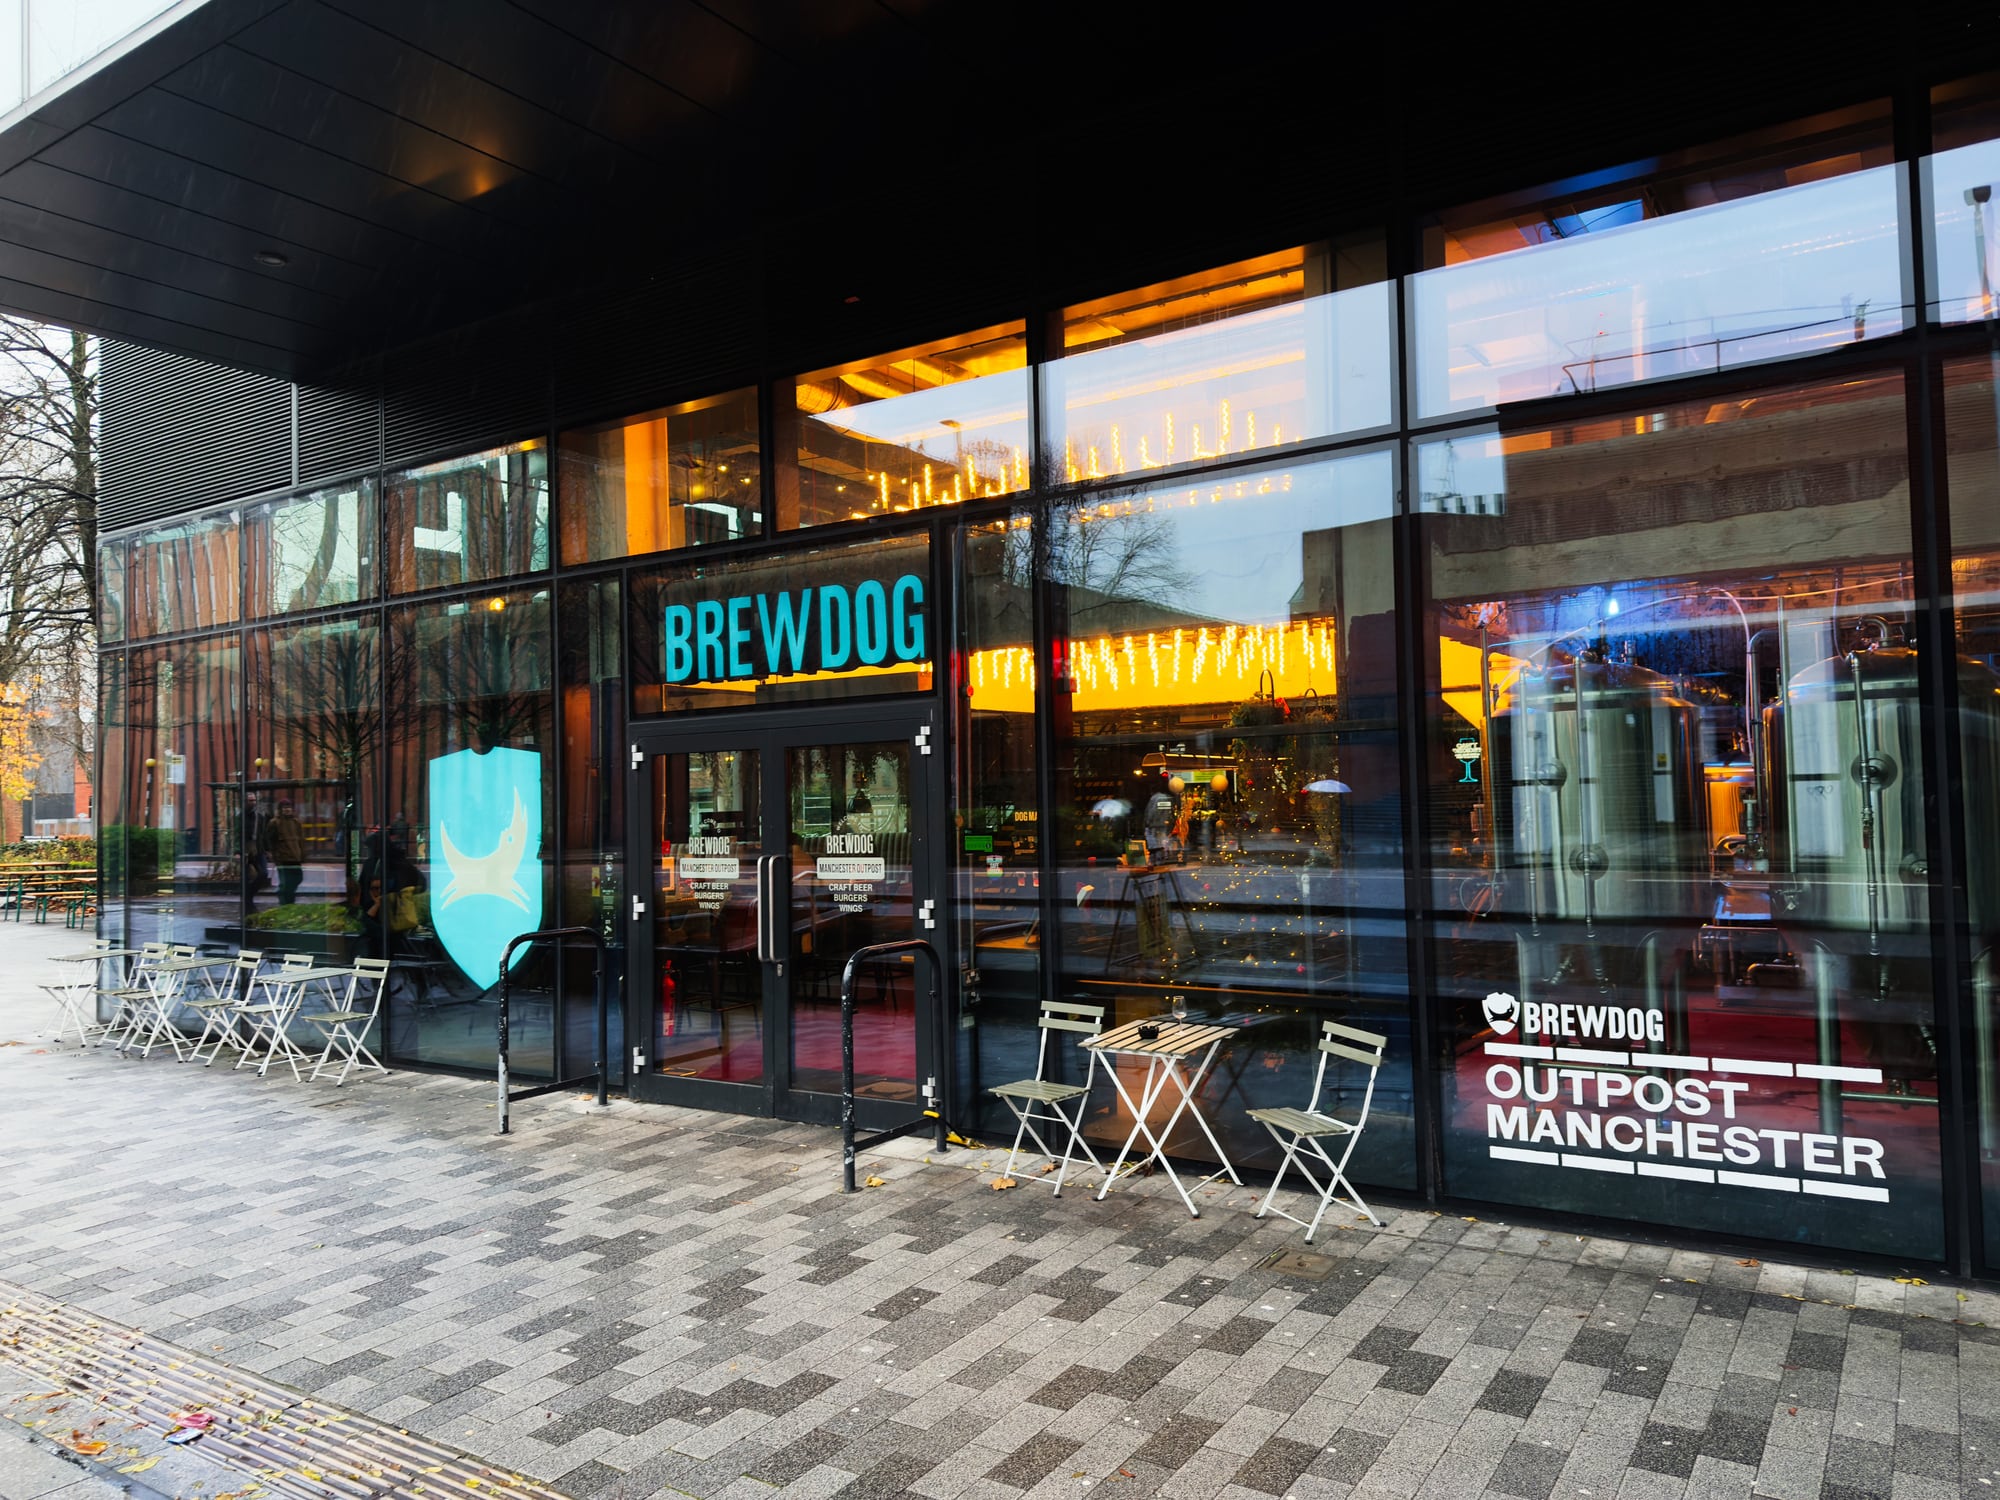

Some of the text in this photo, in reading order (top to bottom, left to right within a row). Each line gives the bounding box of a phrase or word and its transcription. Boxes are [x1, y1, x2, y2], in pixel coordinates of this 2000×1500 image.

[665, 574, 926, 682] BREWDOG
[688, 836, 730, 855] BREWDOG
[826, 834, 874, 854] BREWDOG
[682, 863, 737, 873] MANCHESTER OUTPOST
[819, 863, 882, 874] MANCHESTER OUTPOST
[690, 882, 729, 890] CRAFT BEER
[828, 883, 873, 892] CRAFT BEER
[694, 891, 725, 900] BURGERS
[833, 893, 868, 902] BURGERS
[698, 901, 721, 910] WINGS
[838, 904, 864, 913] WINGS
[1523, 1002, 1665, 1042] BREWDOG
[1485, 1064, 1749, 1119] OUTPOST
[1487, 1104, 1887, 1179] MANCHESTER
